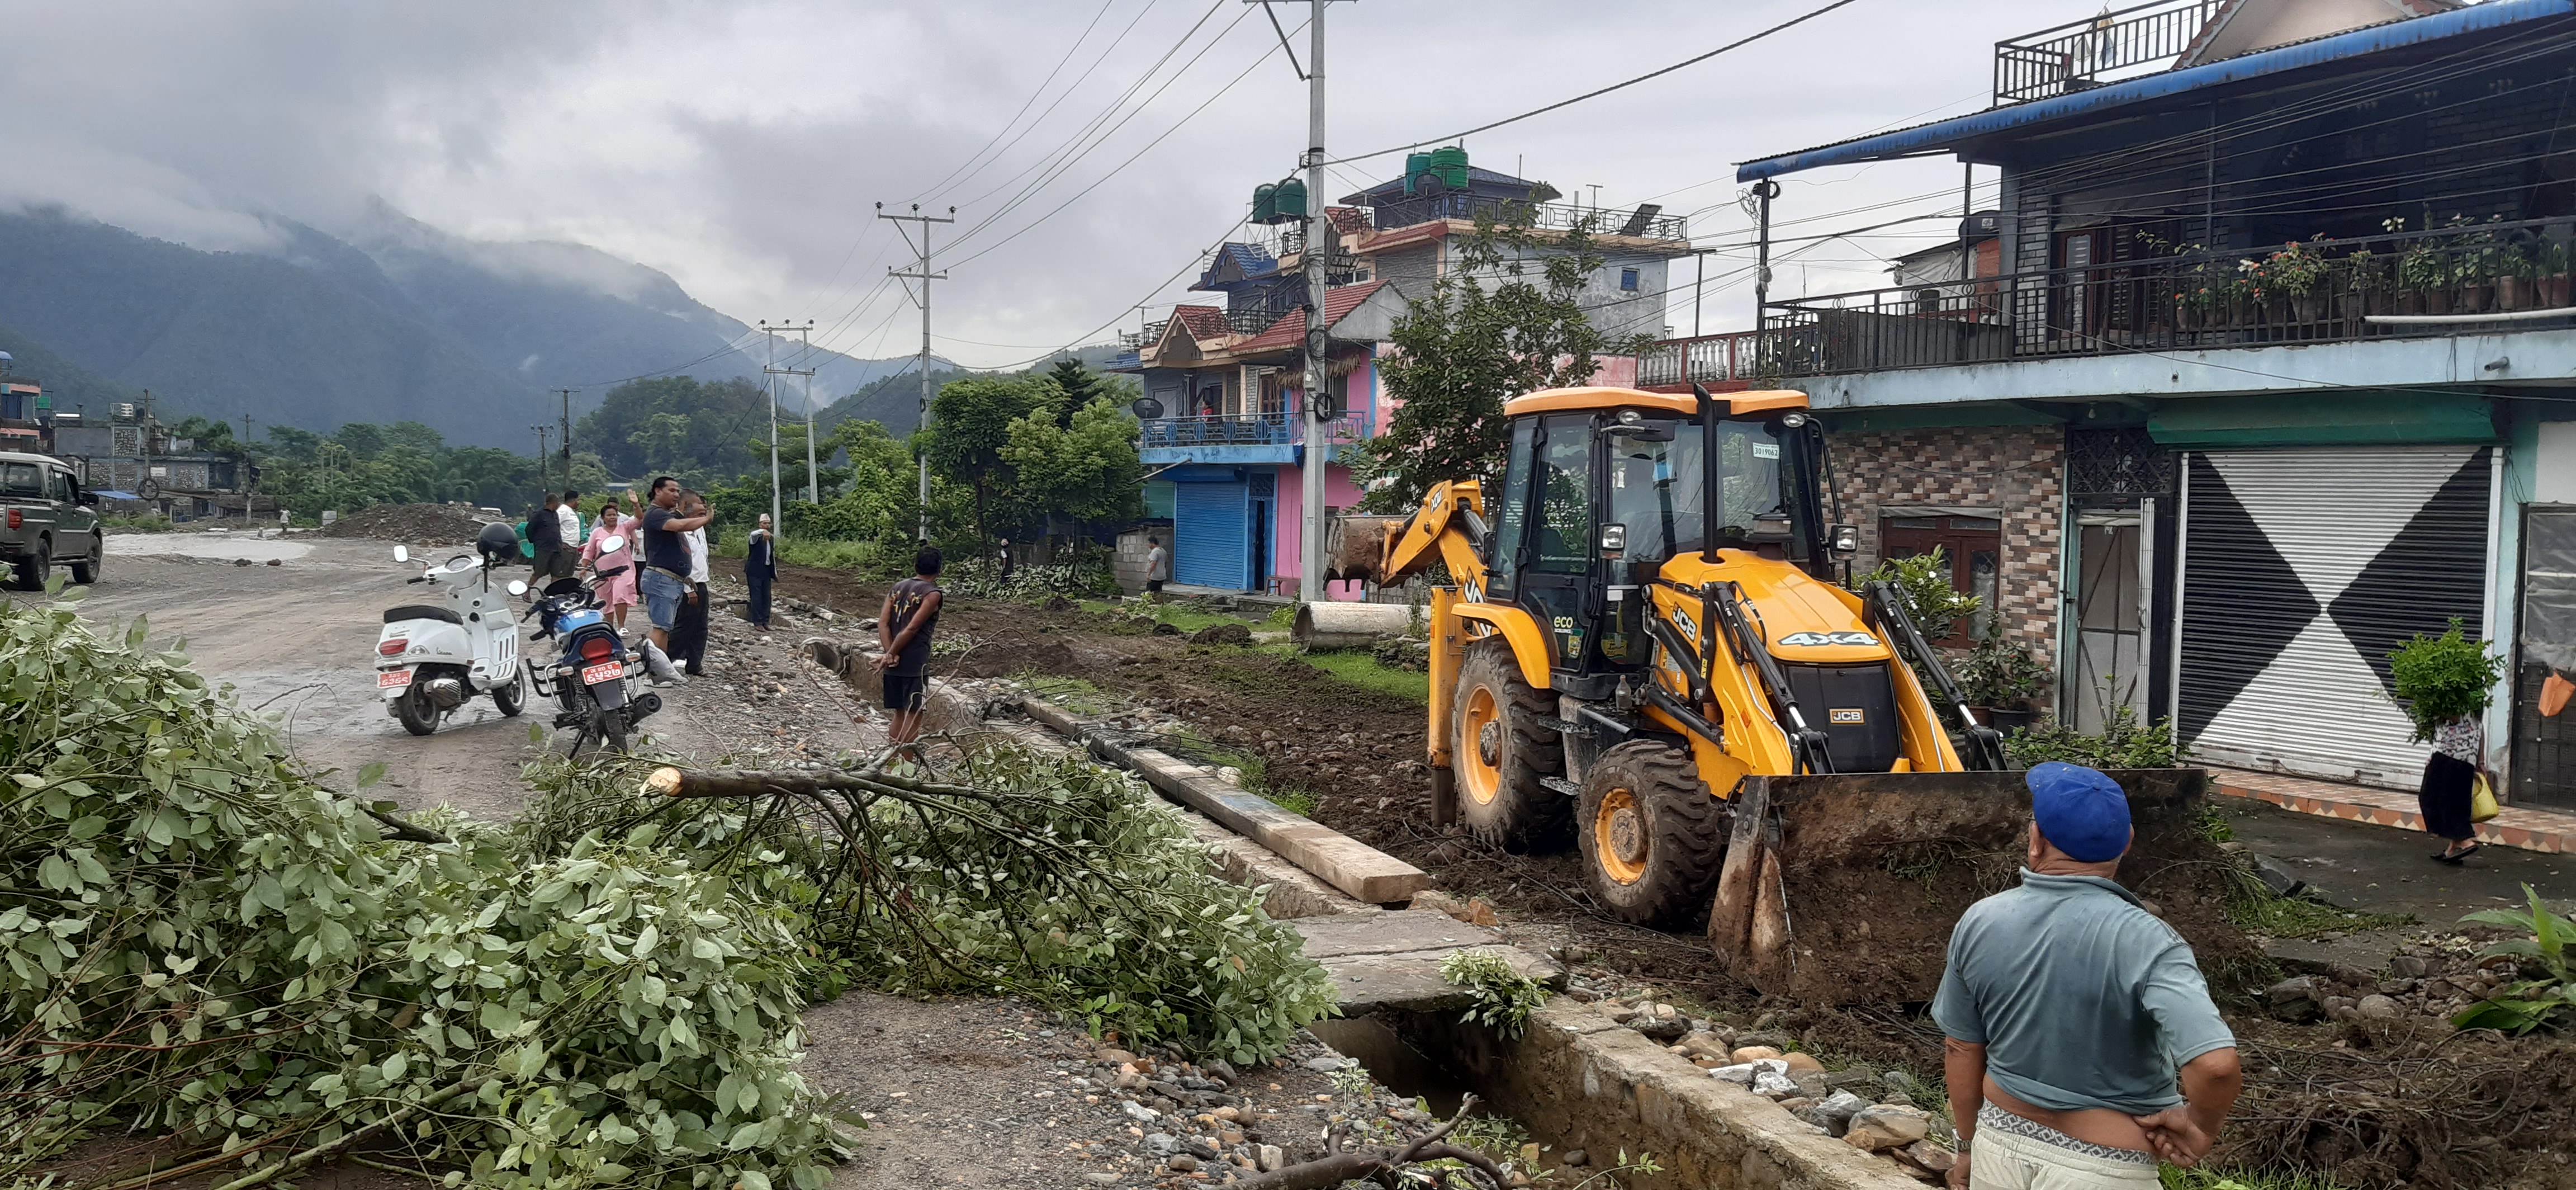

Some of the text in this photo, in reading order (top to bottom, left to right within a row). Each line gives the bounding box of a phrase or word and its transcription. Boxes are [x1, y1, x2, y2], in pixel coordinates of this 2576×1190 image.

[1755, 447, 1778, 456] 3019062
[1554, 616, 1574, 628] eco
[1672, 607, 1697, 641] JCB
[586, 669, 621, 682] ६५२७
[1832, 711, 1861, 721] JCB
